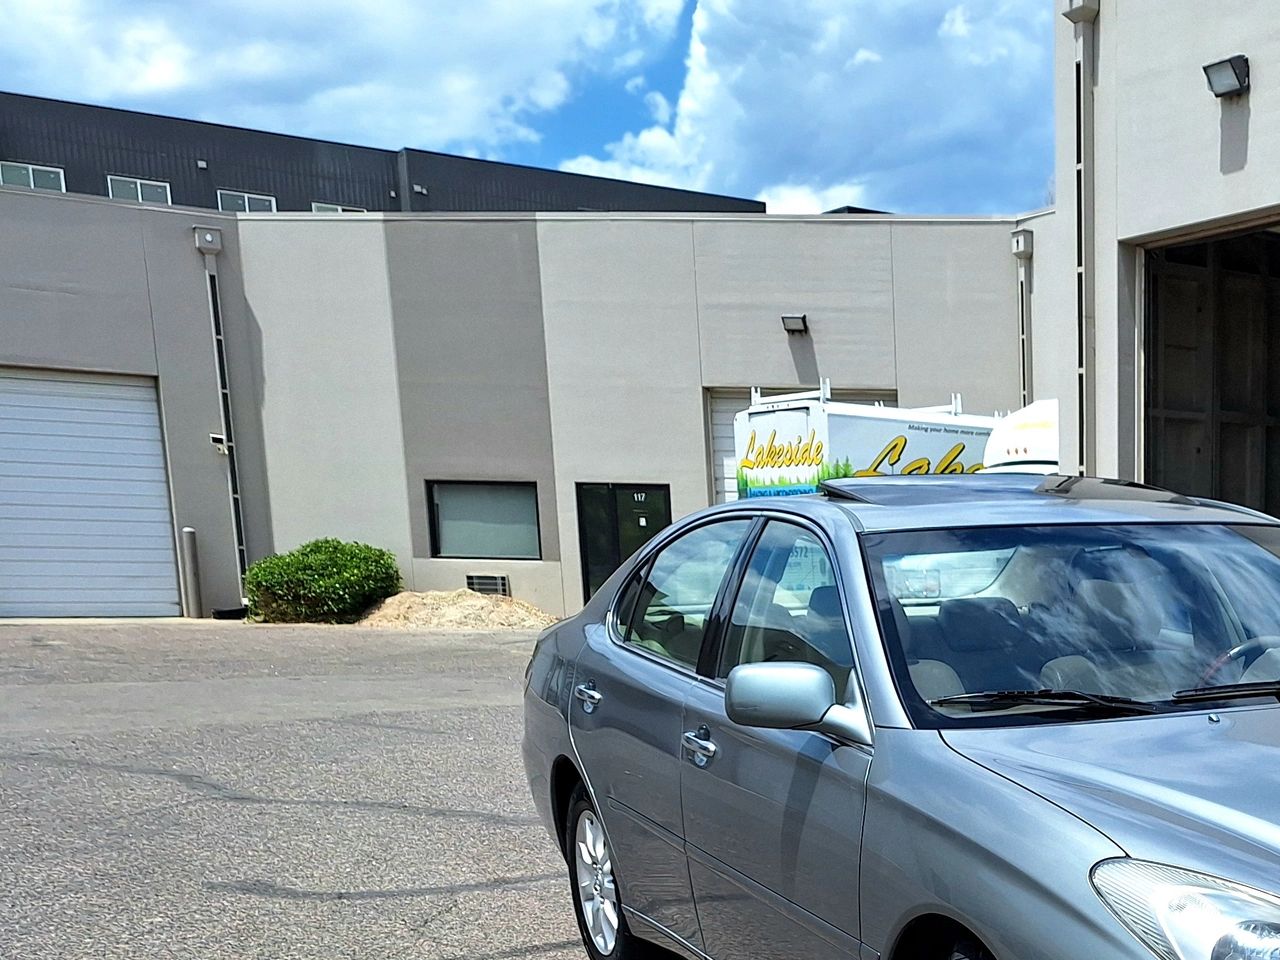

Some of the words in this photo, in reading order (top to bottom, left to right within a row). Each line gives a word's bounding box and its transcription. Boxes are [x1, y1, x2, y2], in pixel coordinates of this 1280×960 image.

[908, 424, 929, 433] Making
[740, 428, 823, 470] Lakeside
[633, 492, 646, 501] 117
